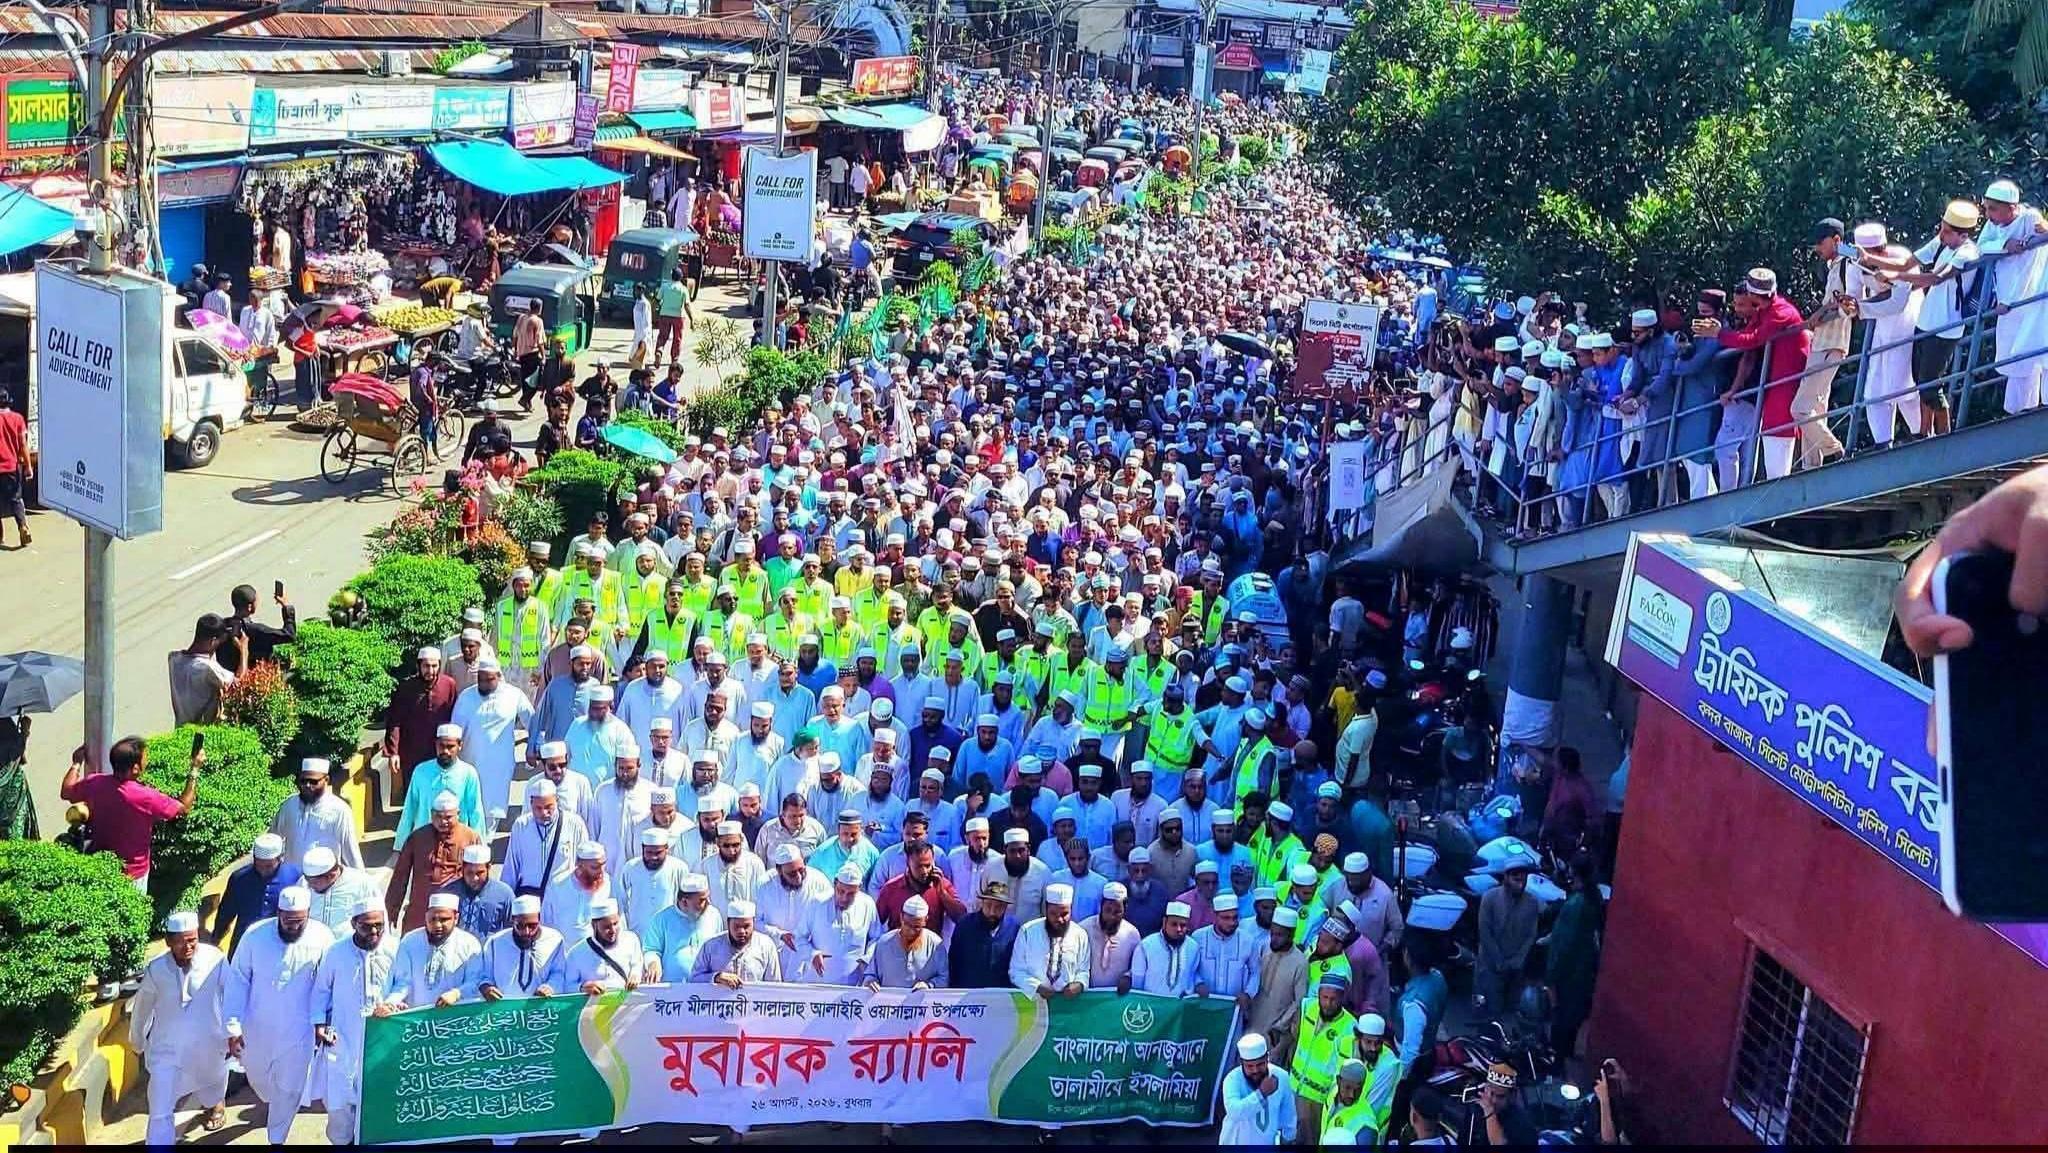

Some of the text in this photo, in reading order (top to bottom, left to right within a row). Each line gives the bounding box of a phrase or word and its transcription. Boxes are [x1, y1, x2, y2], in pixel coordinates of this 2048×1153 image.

[8, 93, 69, 123] সালমান
[755, 175, 805, 189] CALL FOR
[755, 188, 804, 199] ADVERTISEMENT
[48, 327, 113, 371] CALL FOR
[49, 357, 113, 392] ADVERTISEMENT
[1640, 597, 1676, 628] FALCON
[1694, 630, 1789, 723] ট্রাফিক
[1794, 703, 1885, 789] পুলিশ
[1723, 716, 1755, 753] বাজার,
[1758, 736, 1789, 772] সিলেট
[1789, 763, 1855, 818] মেট্রোপলিটন
[1857, 807, 1891, 846] পুলিশ,
[655, 998, 683, 1017] ঈদে
[688, 995, 749, 1019] মীলাদুন্নবী
[810, 999, 865, 1021] আলাইহি
[656, 1029, 836, 1098] মুবারক
[1052, 1035, 1209, 1068] বাংলাদেশ আনজুমানে
[1048, 1069, 1202, 1101] তালামীযে ইসলামিয়া
[751, 1100, 766, 1110] ২৬
